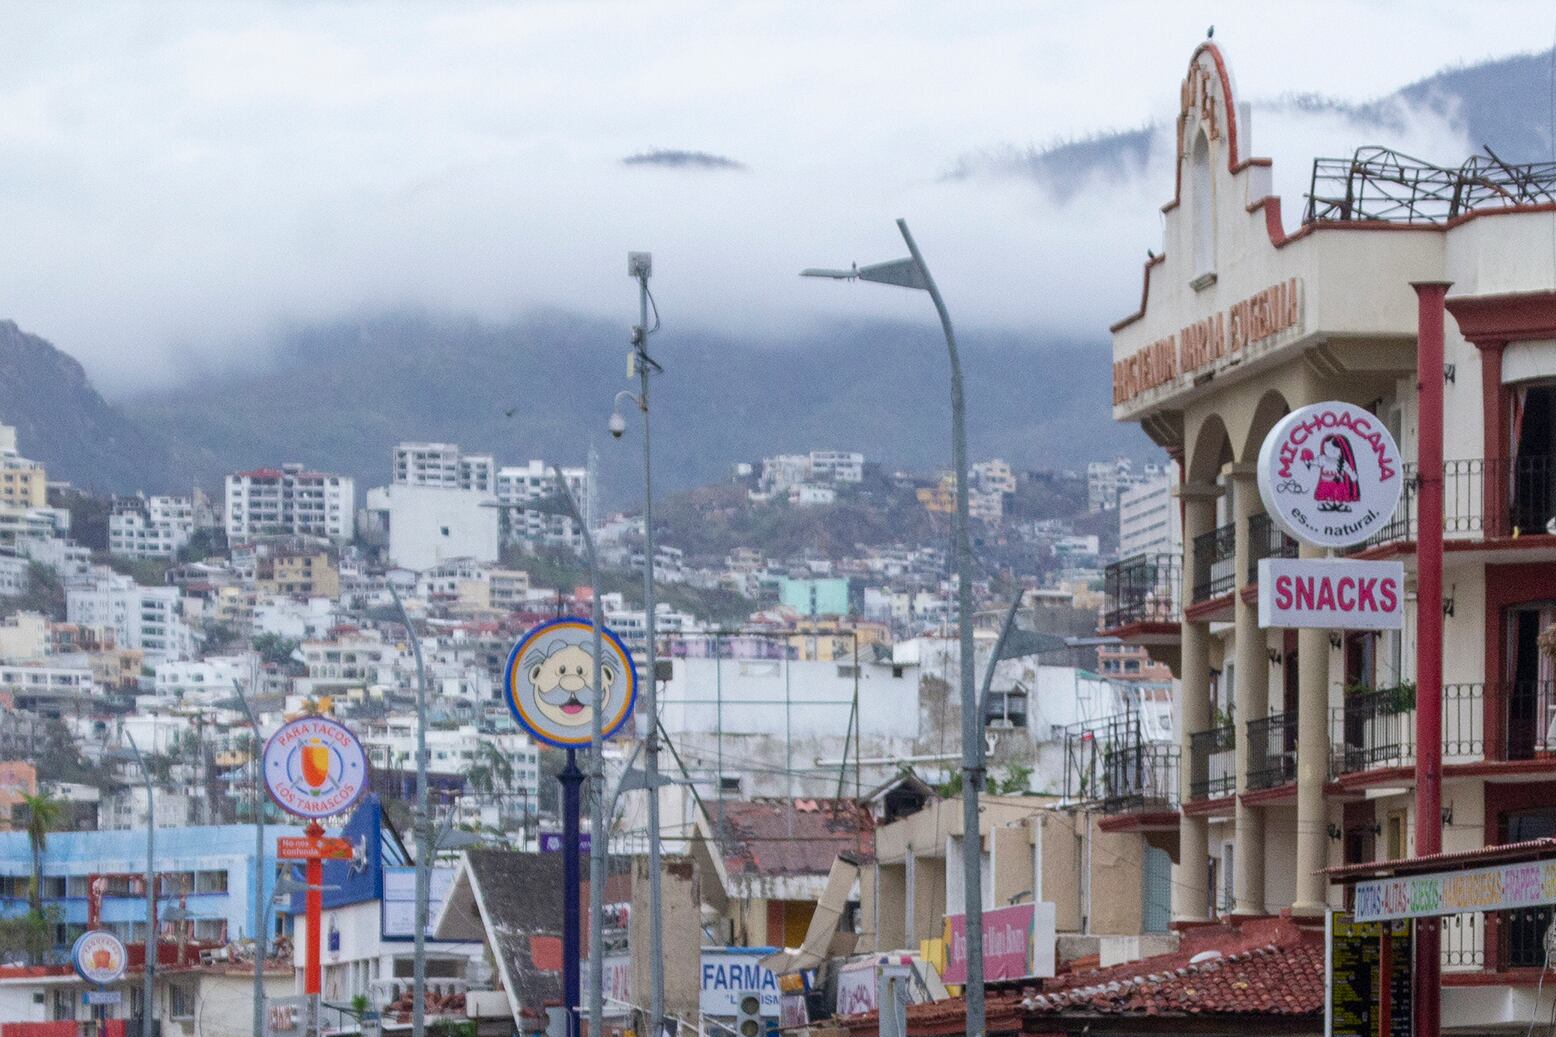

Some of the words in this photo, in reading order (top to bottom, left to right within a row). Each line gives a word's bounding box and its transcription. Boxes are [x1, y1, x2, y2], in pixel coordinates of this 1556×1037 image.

[1277, 410, 1396, 482] MICHOACANA
[1275, 574, 1398, 613] SNACKS
[278, 725, 309, 747] PARA
[312, 722, 352, 748] TACOS
[275, 782, 297, 804] LOS
[296, 784, 354, 812] TARASCOS
[703, 963, 777, 991] FARMA
